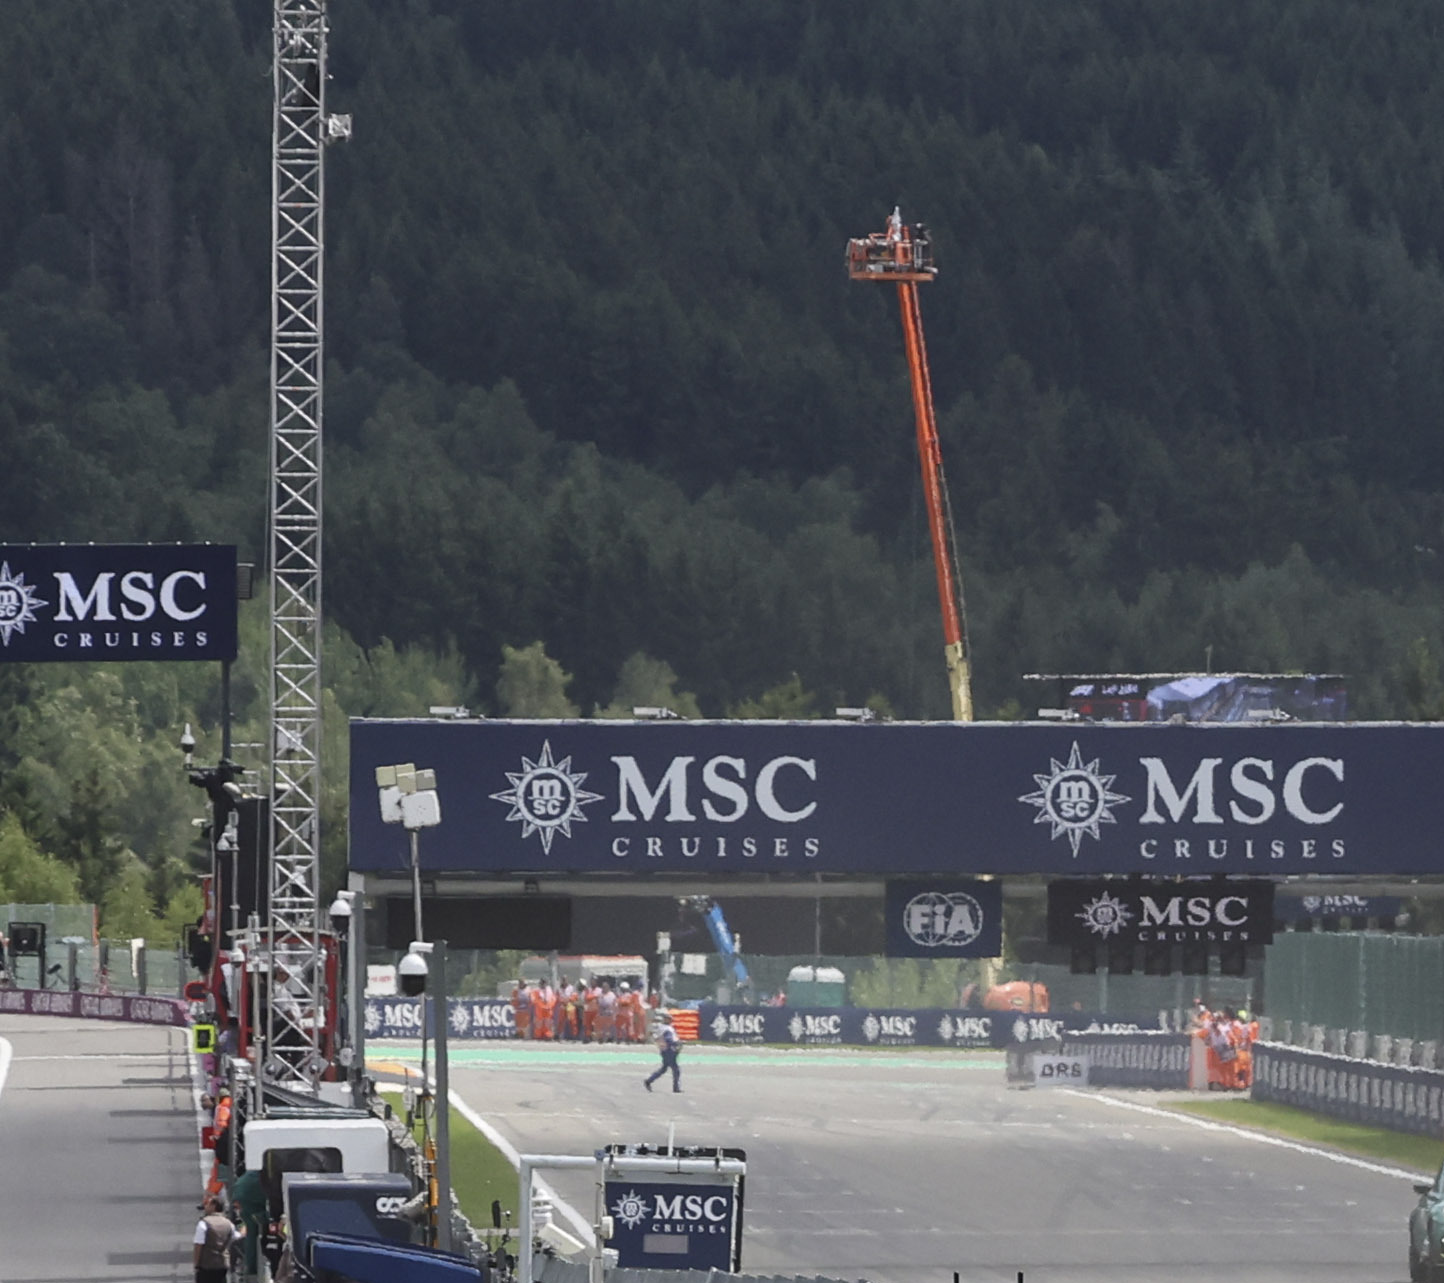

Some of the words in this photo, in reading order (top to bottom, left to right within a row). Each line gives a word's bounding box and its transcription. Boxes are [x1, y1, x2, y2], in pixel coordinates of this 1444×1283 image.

[54, 570, 207, 621] MSC
[54, 632, 208, 647] CRUISES
[611, 755, 817, 823] MSC
[1139, 757, 1345, 825] MSC
[612, 838, 819, 858] CRUISES
[1140, 839, 1346, 858] CRUISES
[1138, 896, 1249, 927] MSC
[1139, 931, 1249, 941] CRUISES
[473, 1004, 515, 1027] MSC
[1041, 1063, 1082, 1077] DRS
[653, 1195, 727, 1221] MSC
[652, 1224, 726, 1233] CRUISES
